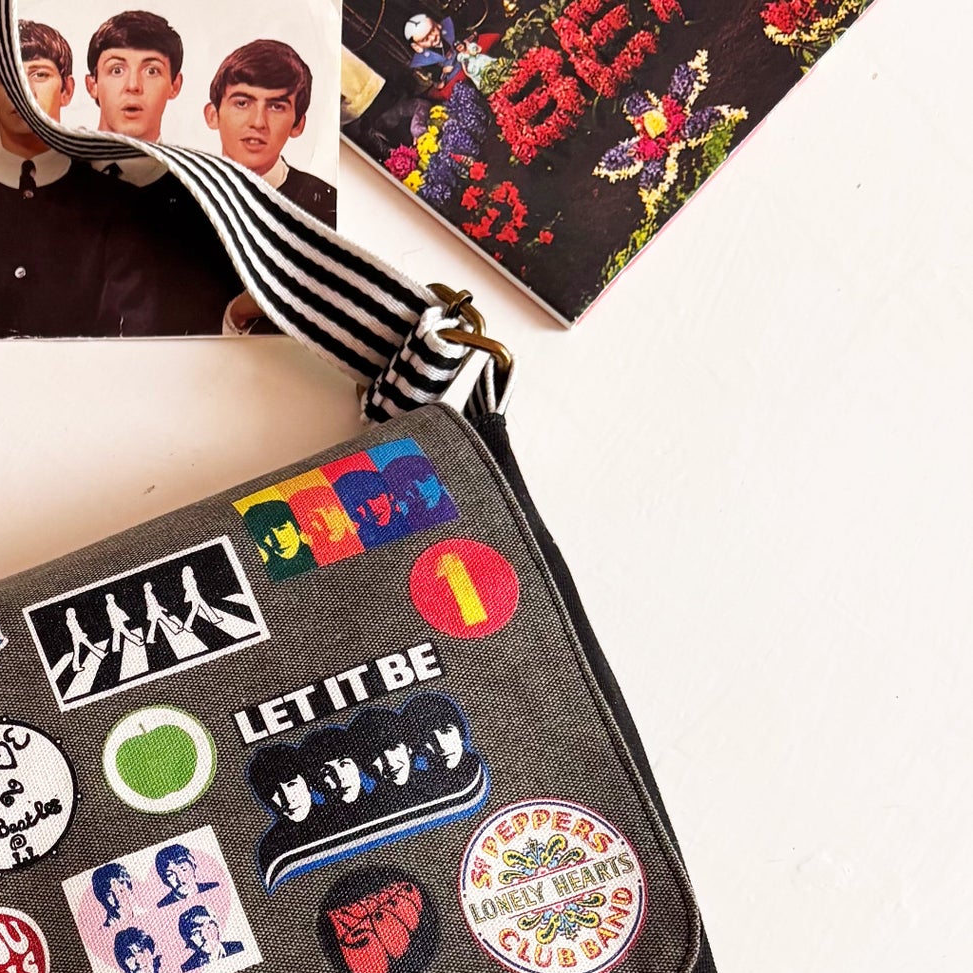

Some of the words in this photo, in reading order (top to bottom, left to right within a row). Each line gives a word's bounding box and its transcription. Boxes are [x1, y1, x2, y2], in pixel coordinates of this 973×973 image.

[436, 553, 488, 627] 1
[233, 685, 315, 744] LET
[323, 664, 369, 711] IT
[375, 642, 442, 692] BE
[481, 809, 615, 859] PEPPERS
[468, 881, 546, 925] LONELY
[551, 852, 635, 897] HEARTS
[498, 927, 577, 969] CLUB
[579, 887, 634, 960] BAND
